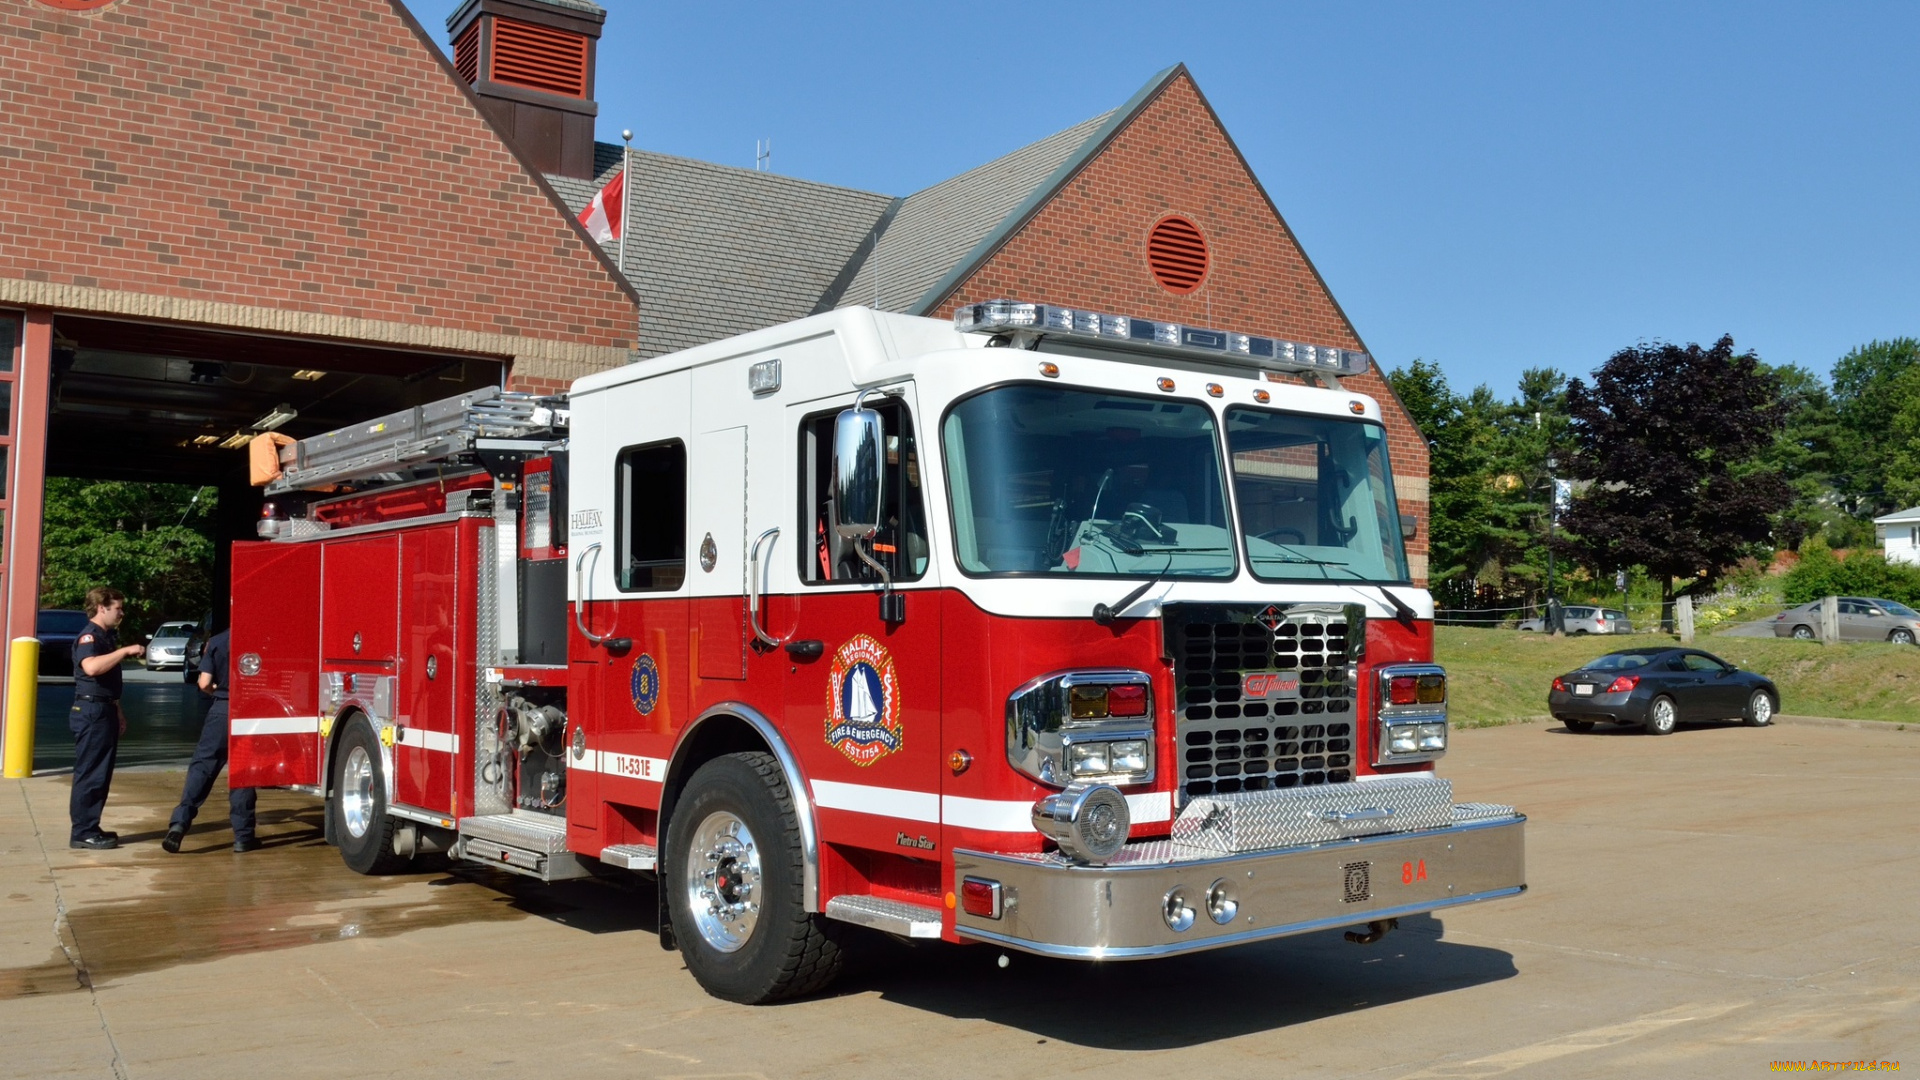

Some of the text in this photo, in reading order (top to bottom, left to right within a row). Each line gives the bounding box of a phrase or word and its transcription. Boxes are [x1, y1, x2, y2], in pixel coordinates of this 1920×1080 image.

[571, 511, 602, 529] HALIFAX
[841, 638, 882, 660] HALIFAX
[846, 651, 878, 665] REGIONAL
[617, 756, 651, 777] 11-531E
[896, 832, 937, 850] Metro Star
